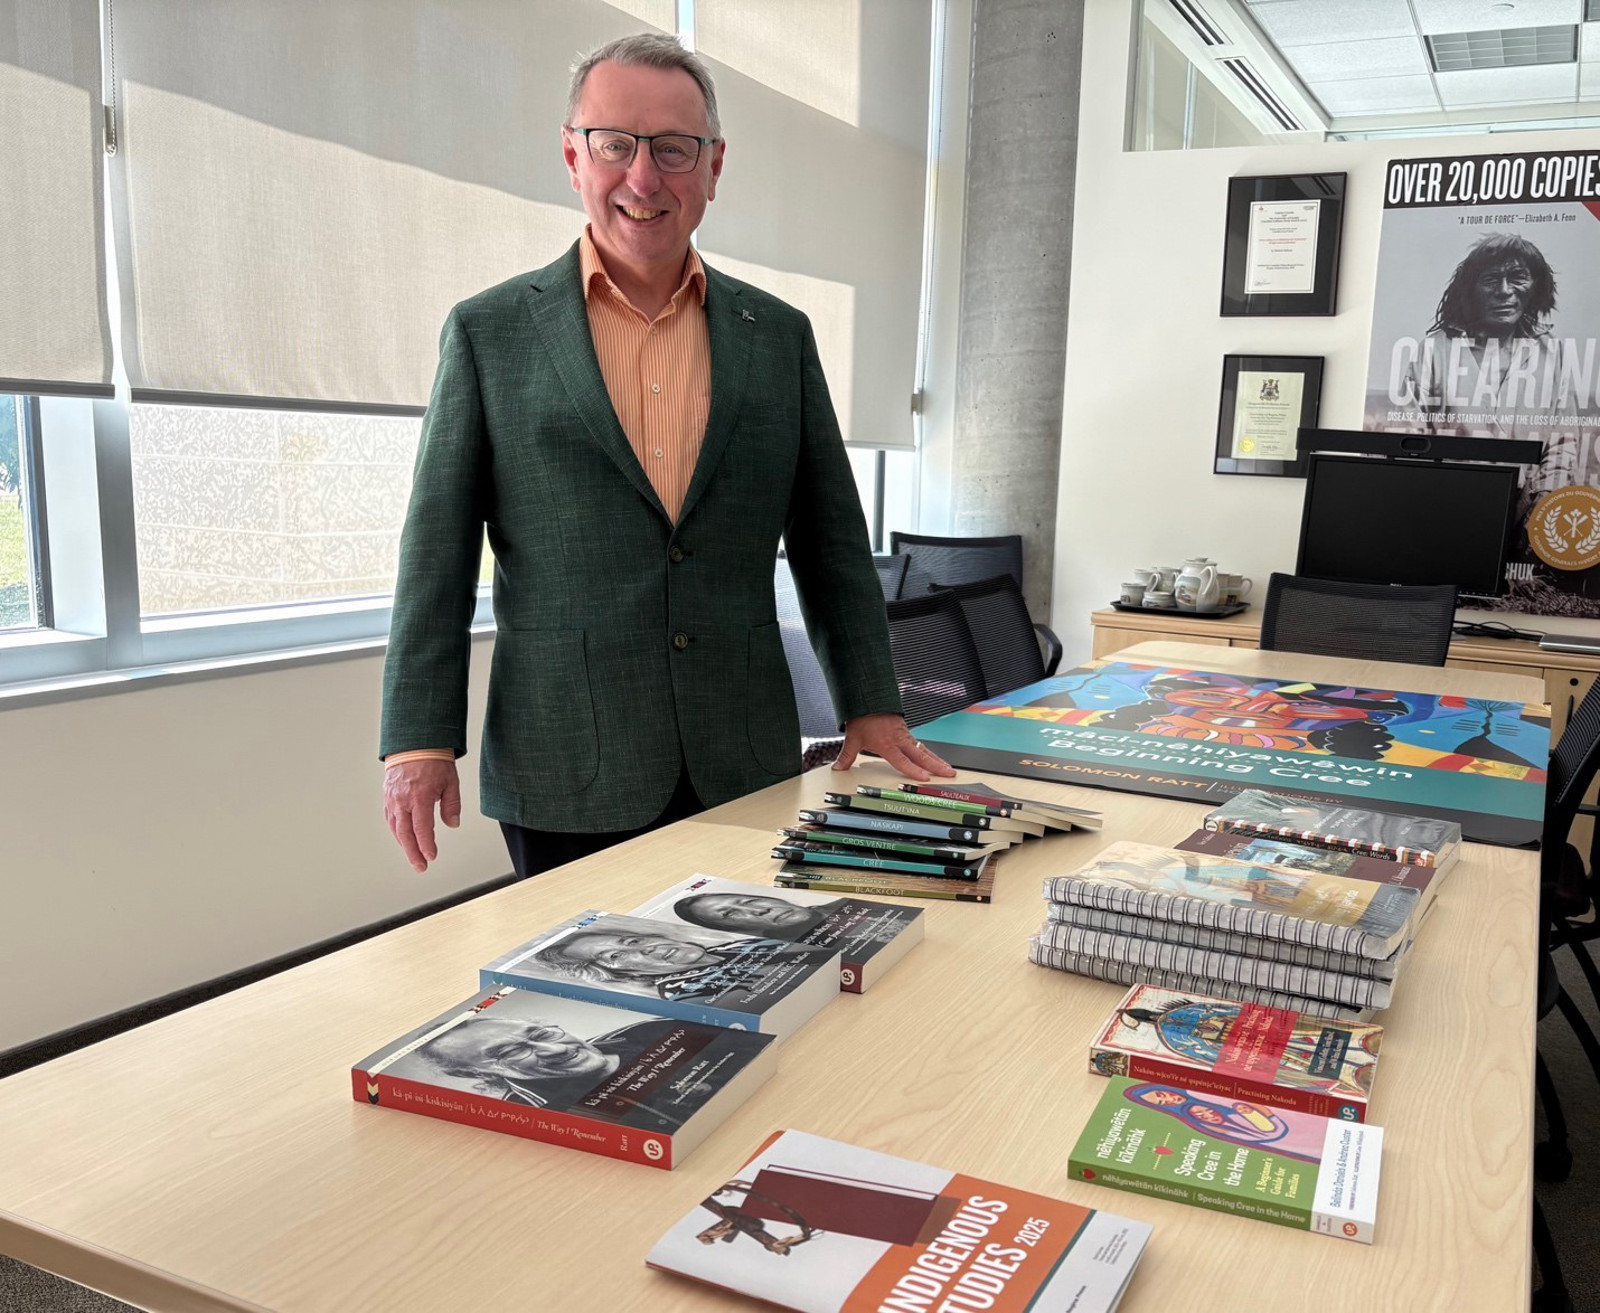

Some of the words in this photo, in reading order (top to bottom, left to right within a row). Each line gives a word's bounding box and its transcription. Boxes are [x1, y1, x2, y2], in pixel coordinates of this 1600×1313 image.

[1388, 162, 1443, 204] OVER
[1445, 158, 1526, 204] 20,000
[1466, 215, 1483, 225] TOUR
[1484, 215, 1493, 224] DE
[1388, 336, 1600, 410] CLEARIN
[1417, 412, 1446, 423] POLITICS
[1447, 413, 1456, 424] OF
[1501, 414, 1514, 425] AND
[1516, 414, 1529, 425] THE
[1530, 415, 1549, 426] LOSS
[1549, 415, 1559, 426] OF
[1047, 739, 1254, 774] Beginning
[1269, 766, 1371, 787] Cree
[1018, 758, 1142, 780] SOLOMON
[1146, 776, 1208, 789] RATT
[940, 790, 970, 801] SAULTEAUX
[870, 821, 904, 831] NASKAPI
[842, 837, 864, 847] GROS
[866, 839, 897, 851] VENTRE
[863, 859, 885, 868] CREE
[1370, 850, 1391, 860] Words
[855, 886, 905, 896] BLACKFOOT
[1237, 1087, 1270, 1101] Practising
[1271, 1092, 1297, 1106] Nakoda
[537, 1120, 549, 1130] The
[550, 1123, 565, 1134] Way
[571, 1128, 607, 1143] Remember
[1173, 1138, 1206, 1176] Speaking
[1204, 1151, 1222, 1161] in
[1226, 1147, 1249, 1173] Home
[1196, 1159, 1219, 1181] Cree
[1223, 1171, 1242, 1187] the
[1275, 1166, 1286, 1178] for
[1270, 1177, 1283, 1195] Guide
[1285, 1173, 1300, 1199] Families
[1197, 1193, 1235, 1210] Speaking
[1236, 1202, 1256, 1213] Cree
[1256, 1205, 1265, 1214] in
[1266, 1207, 1280, 1218] the
[1281, 1210, 1306, 1224] Home
[936, 1242, 1027, 1313] TUDIES
[1013, 1216, 1050, 1247] 2025
